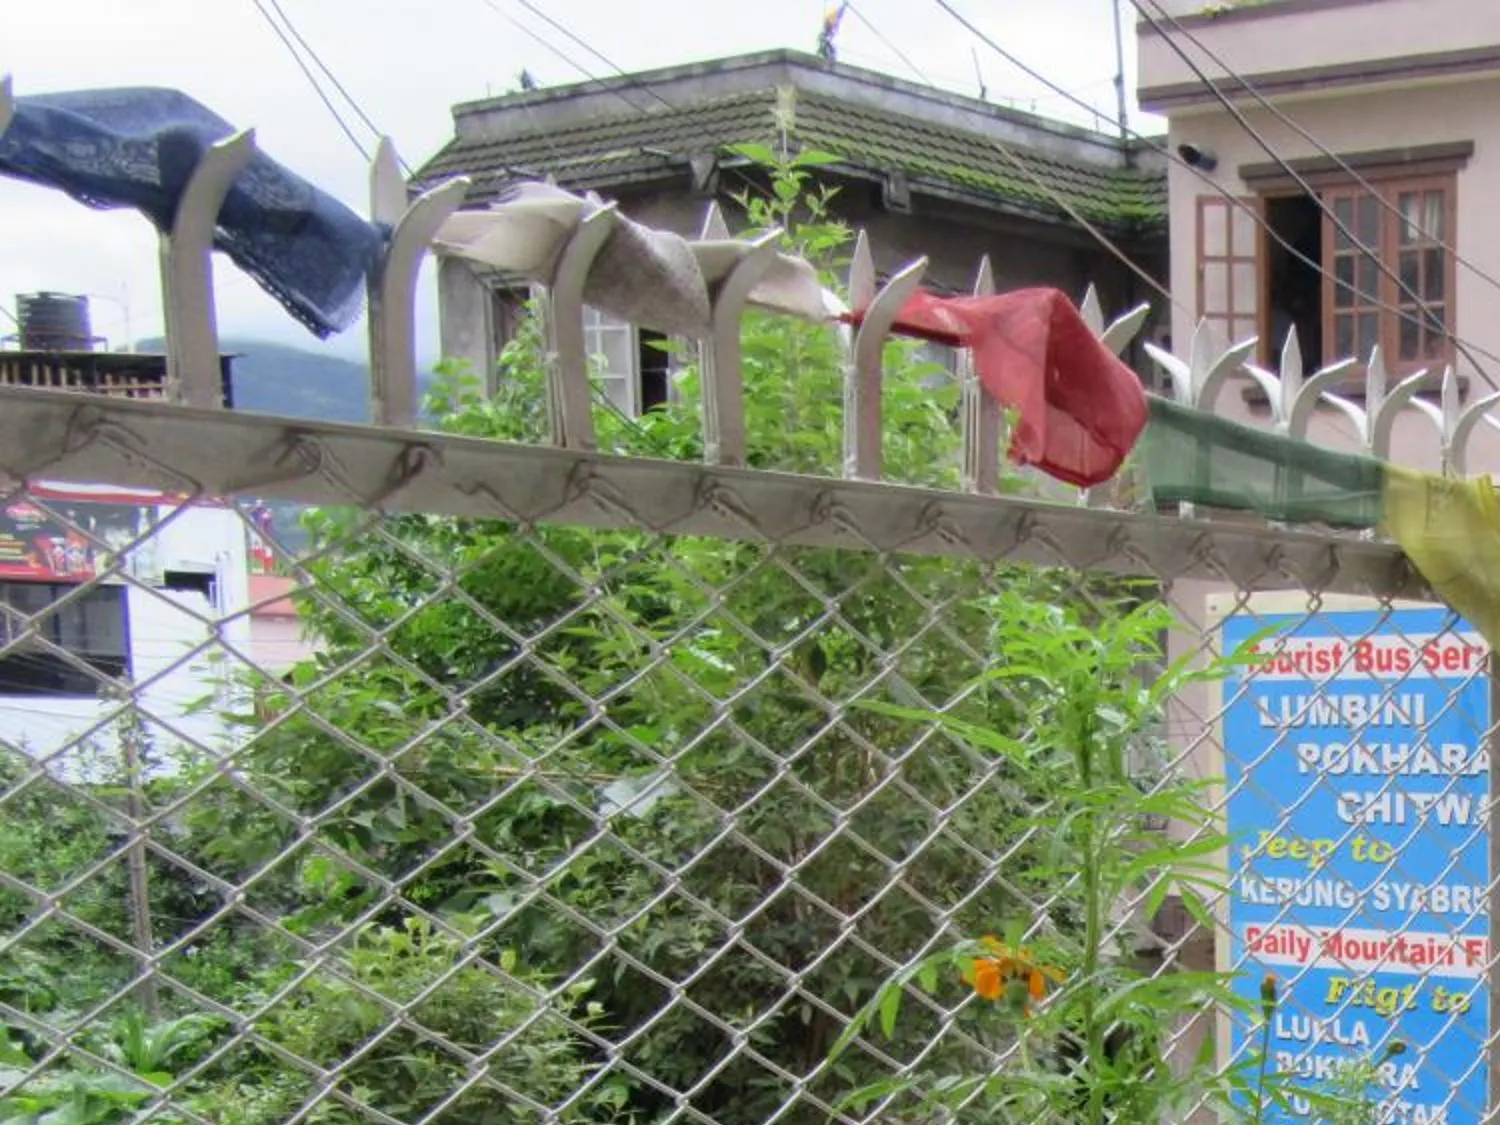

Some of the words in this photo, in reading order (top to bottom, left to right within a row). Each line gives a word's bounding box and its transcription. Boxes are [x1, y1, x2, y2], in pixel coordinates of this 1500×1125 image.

[1354, 640, 1411, 673] Bus
[1259, 693, 1426, 728] LUMBINI
[1297, 742, 1490, 775] POKHARA
[1240, 830, 1336, 869] Jeep
[1351, 834, 1395, 863] to
[1240, 875, 1354, 909] KERUNG
[1245, 927, 1311, 964] Daily
[1320, 930, 1455, 967] Mountain
[1432, 986, 1471, 1014] to
[1275, 1013, 1370, 1046] LUKLA
